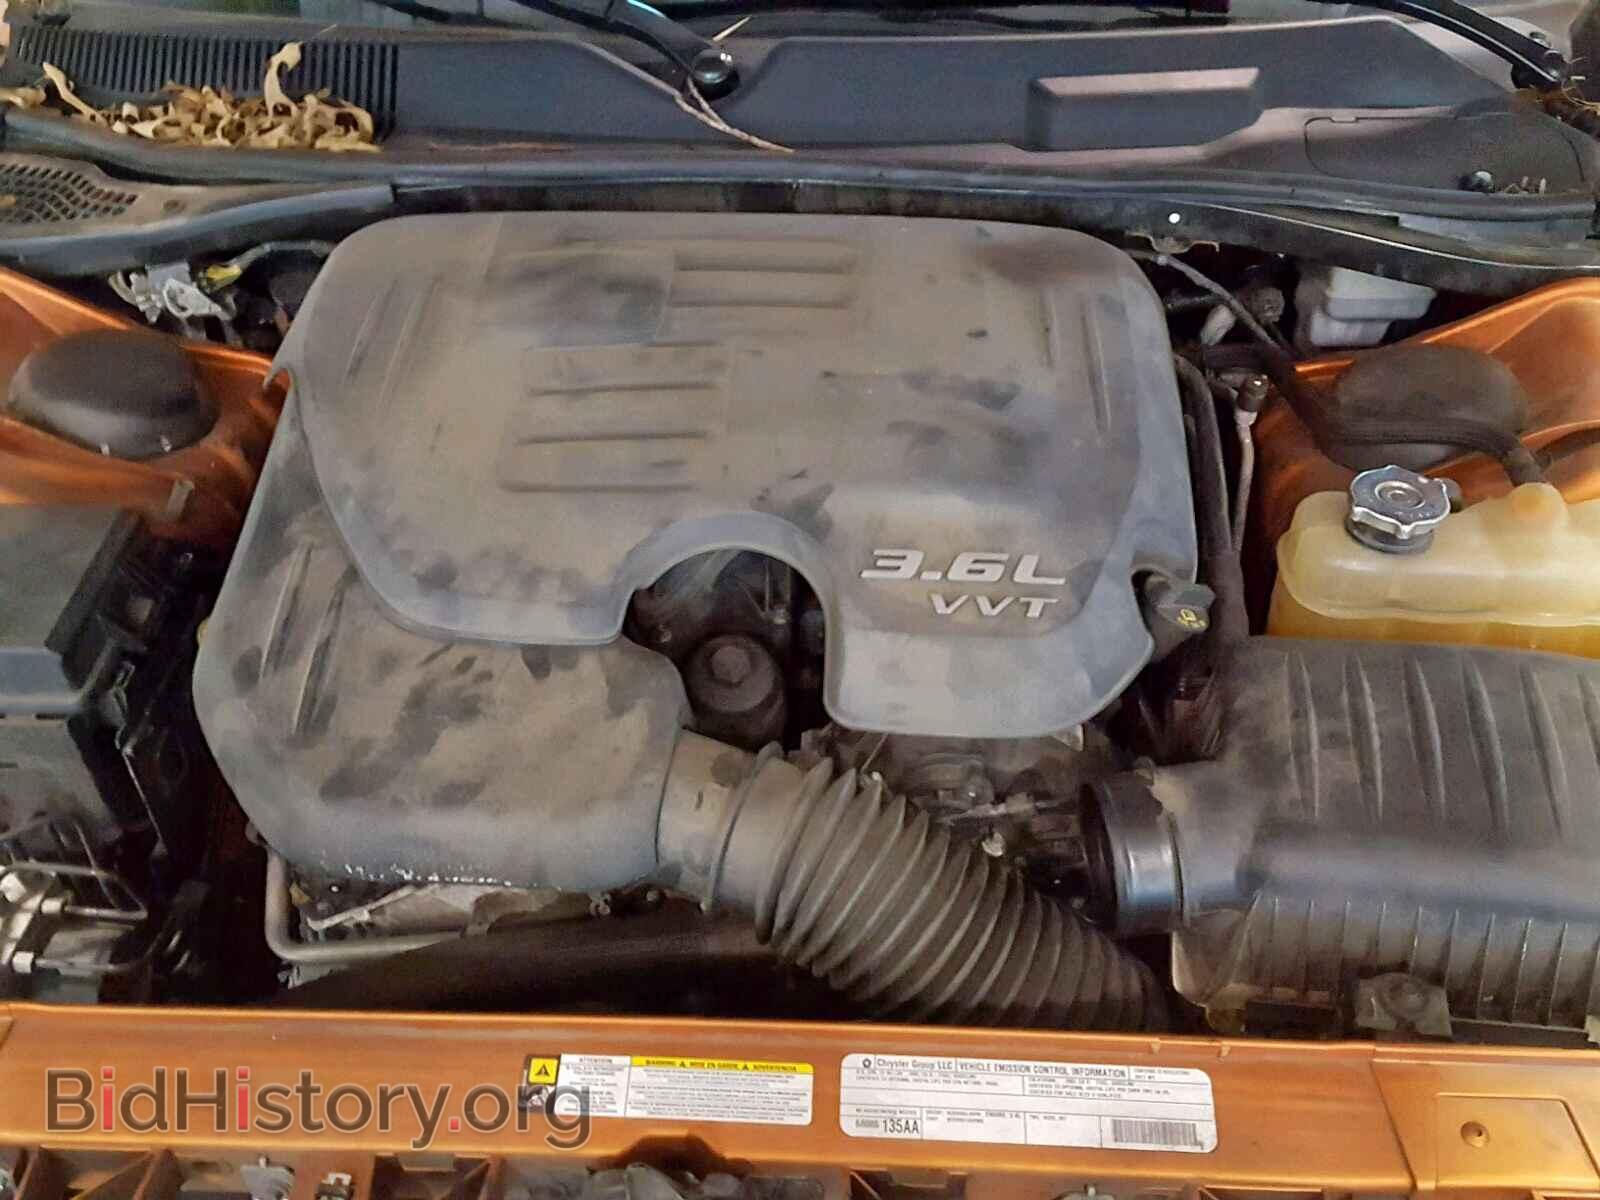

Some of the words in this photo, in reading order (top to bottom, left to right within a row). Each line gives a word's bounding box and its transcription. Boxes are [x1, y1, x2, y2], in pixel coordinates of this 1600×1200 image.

[860, 548, 1067, 585] 3.6L
[930, 593, 1060, 618] VVT
[877, 1058, 909, 1069] Chrysler
[911, 1059, 935, 1070] Group
[937, 1060, 953, 1070] LLC
[959, 1061, 990, 1072] VEHICLE
[994, 1063, 1031, 1073] EMISSION
[1033, 1064, 1069, 1076] CONTROL
[1072, 1066, 1126, 1078] INFORMATION
[883, 1118, 920, 1134] 135AA
